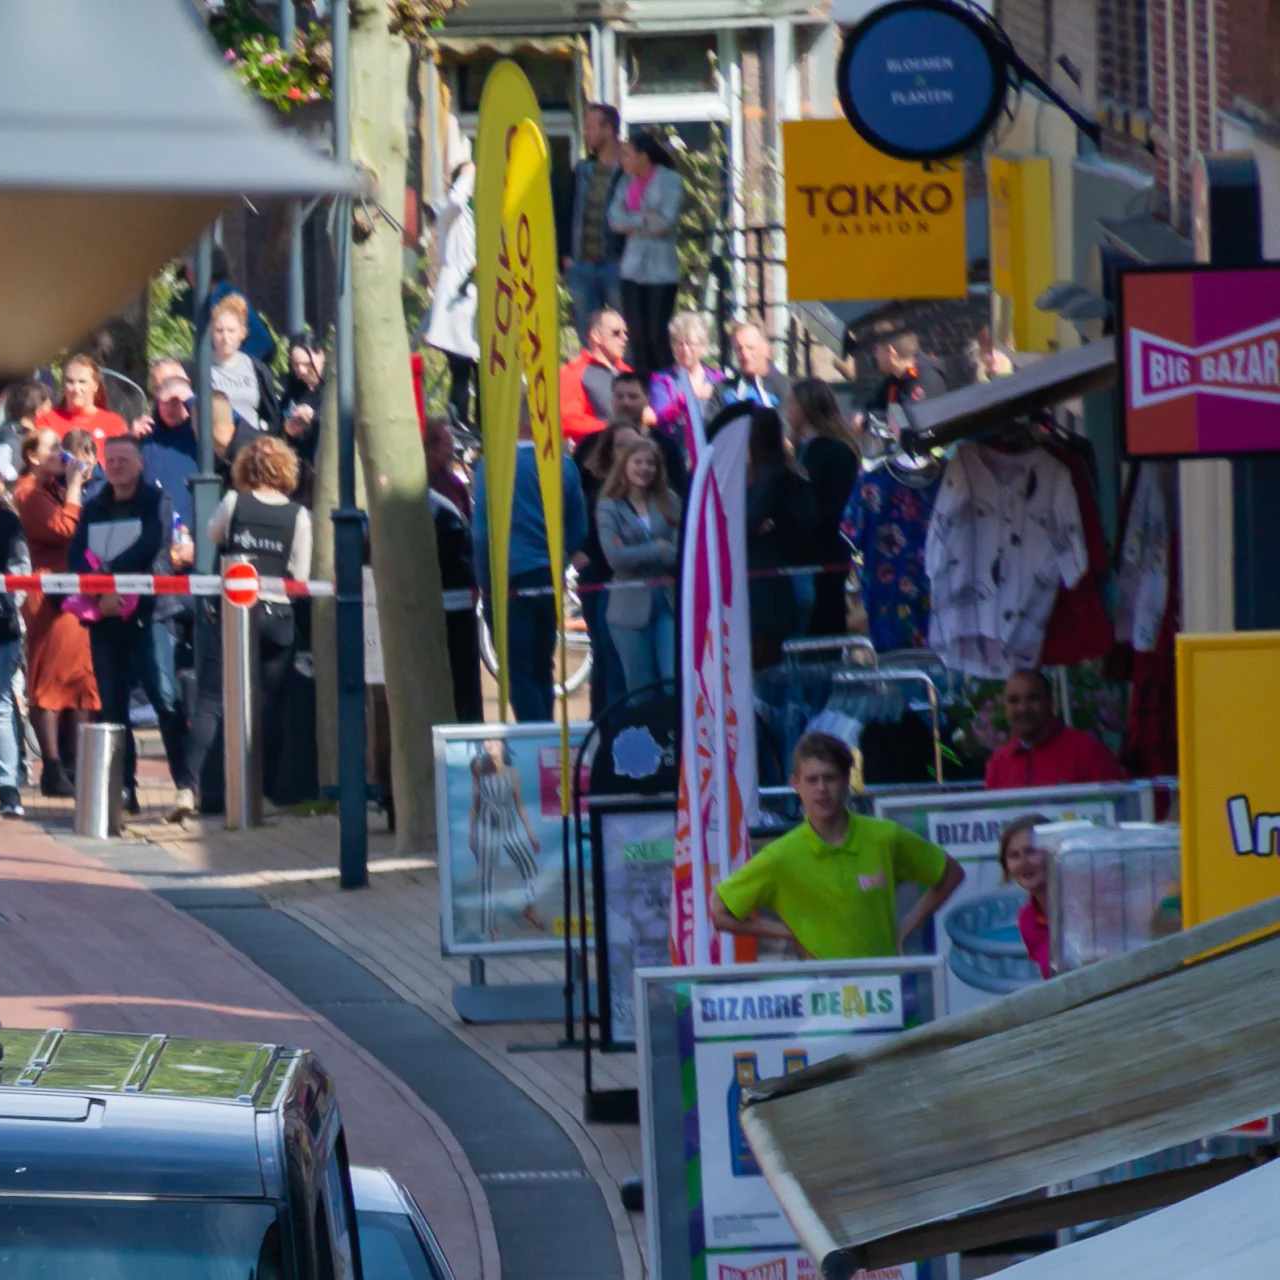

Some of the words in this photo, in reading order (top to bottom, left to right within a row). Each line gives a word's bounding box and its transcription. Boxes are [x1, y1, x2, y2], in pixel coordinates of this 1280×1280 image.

[886, 55, 953, 73] BLOEMEN
[891, 89, 953, 106] PLANTEN
[822, 220, 930, 236] FASHION
[1149, 350, 1191, 388] BIG
[1200, 338, 1280, 386] BAZAR
[700, 994, 805, 1023] BIZARRE
[811, 985, 894, 1019] DEALS
